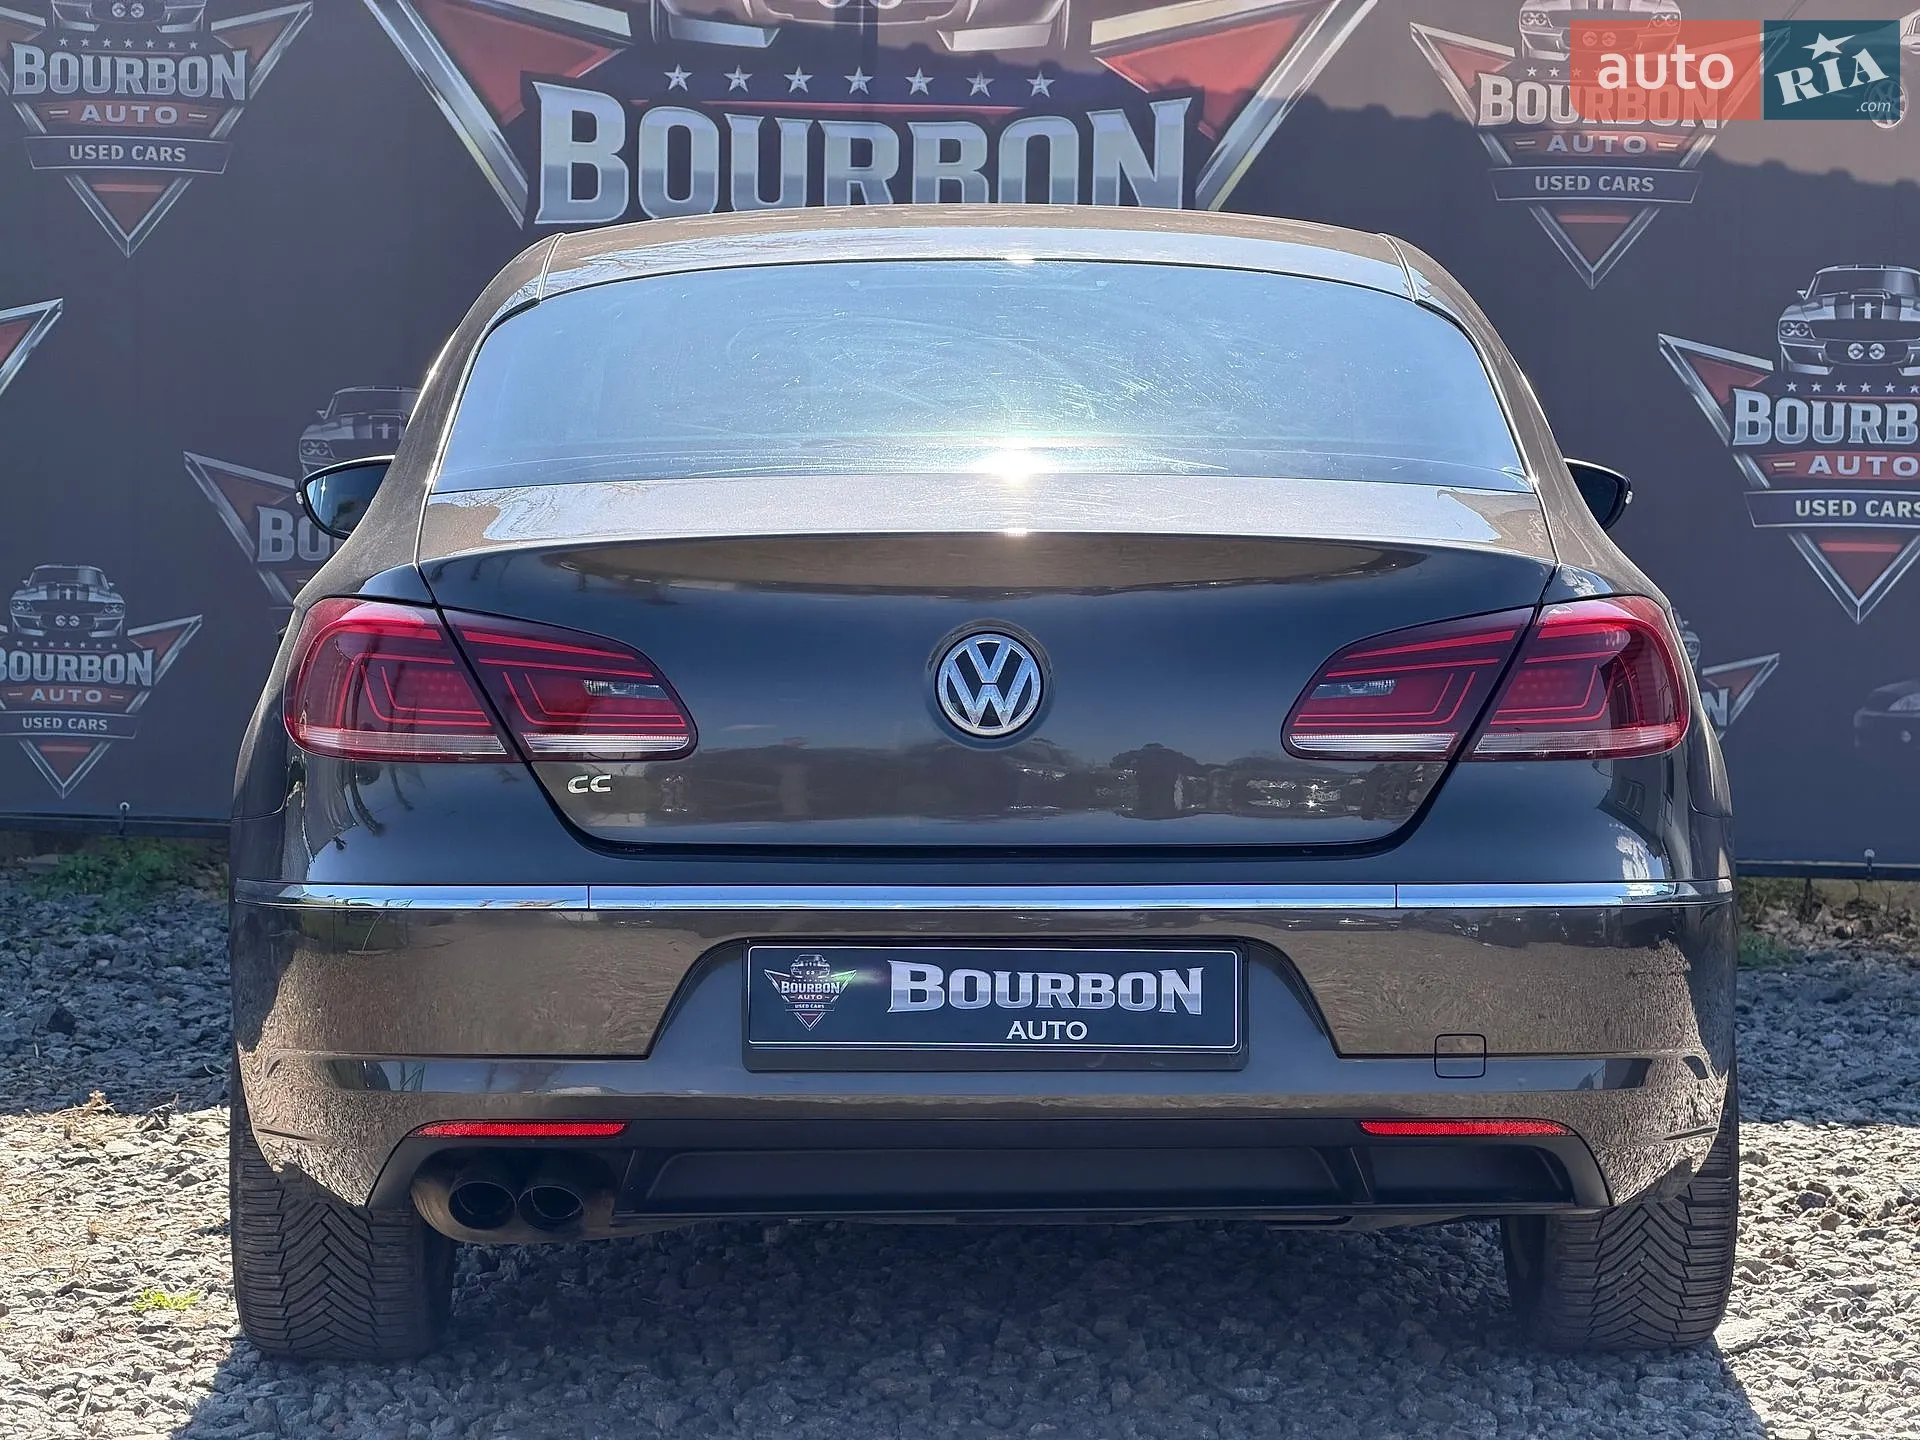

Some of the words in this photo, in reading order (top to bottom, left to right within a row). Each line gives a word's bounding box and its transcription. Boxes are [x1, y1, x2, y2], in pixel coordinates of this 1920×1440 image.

[11, 42, 247, 100] BOURBON
[1478, 72, 1718, 129] BOURBON
[80, 104, 179, 125] AUTO
[69, 144, 125, 161] USED
[131, 146, 187, 163] CARS
[532, 81, 1192, 224] BOURBON
[1547, 134, 1648, 154] AUTO
[1535, 175, 1591, 192] USED
[1598, 175, 1656, 193] CARS
[1807, 454, 1920, 477] AUTO
[1795, 499, 1858, 518] USED
[31, 688, 103, 704] AUTO
[22, 717, 63, 731] USED
[67, 718, 108, 731] CARS
[781, 981, 840, 994] BOURBON
[886, 959, 1205, 1016] BOURBON
[1006, 1020, 1088, 1042] AUTO
